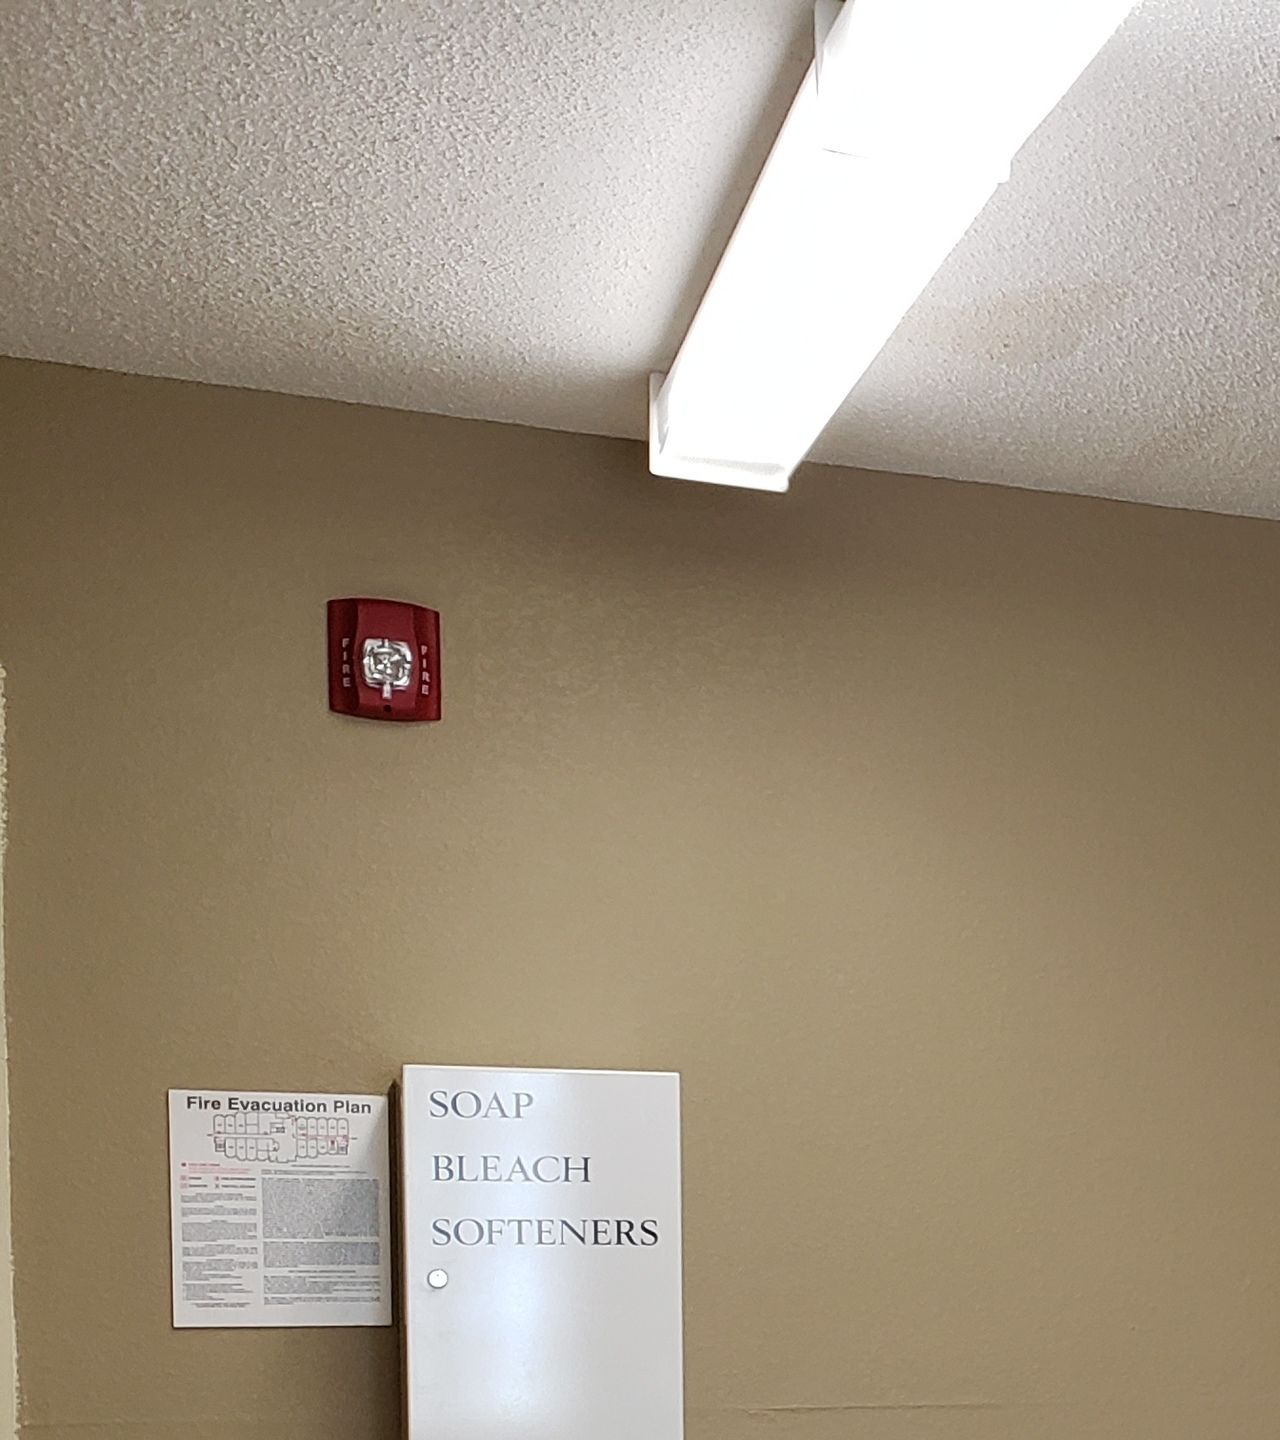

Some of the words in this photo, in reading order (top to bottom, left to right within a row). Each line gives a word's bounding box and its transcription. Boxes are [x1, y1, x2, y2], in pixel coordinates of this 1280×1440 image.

[342, 638, 351, 687] FIRE
[421, 645, 430, 695] FIRE
[187, 1096, 221, 1110] Fire
[228, 1098, 330, 1113] Evacuation
[334, 1100, 371, 1114] Plan
[429, 1090, 534, 1119] SOAP
[433, 1155, 591, 1182] BLEACH
[431, 1218, 658, 1246] SOFTENERS
